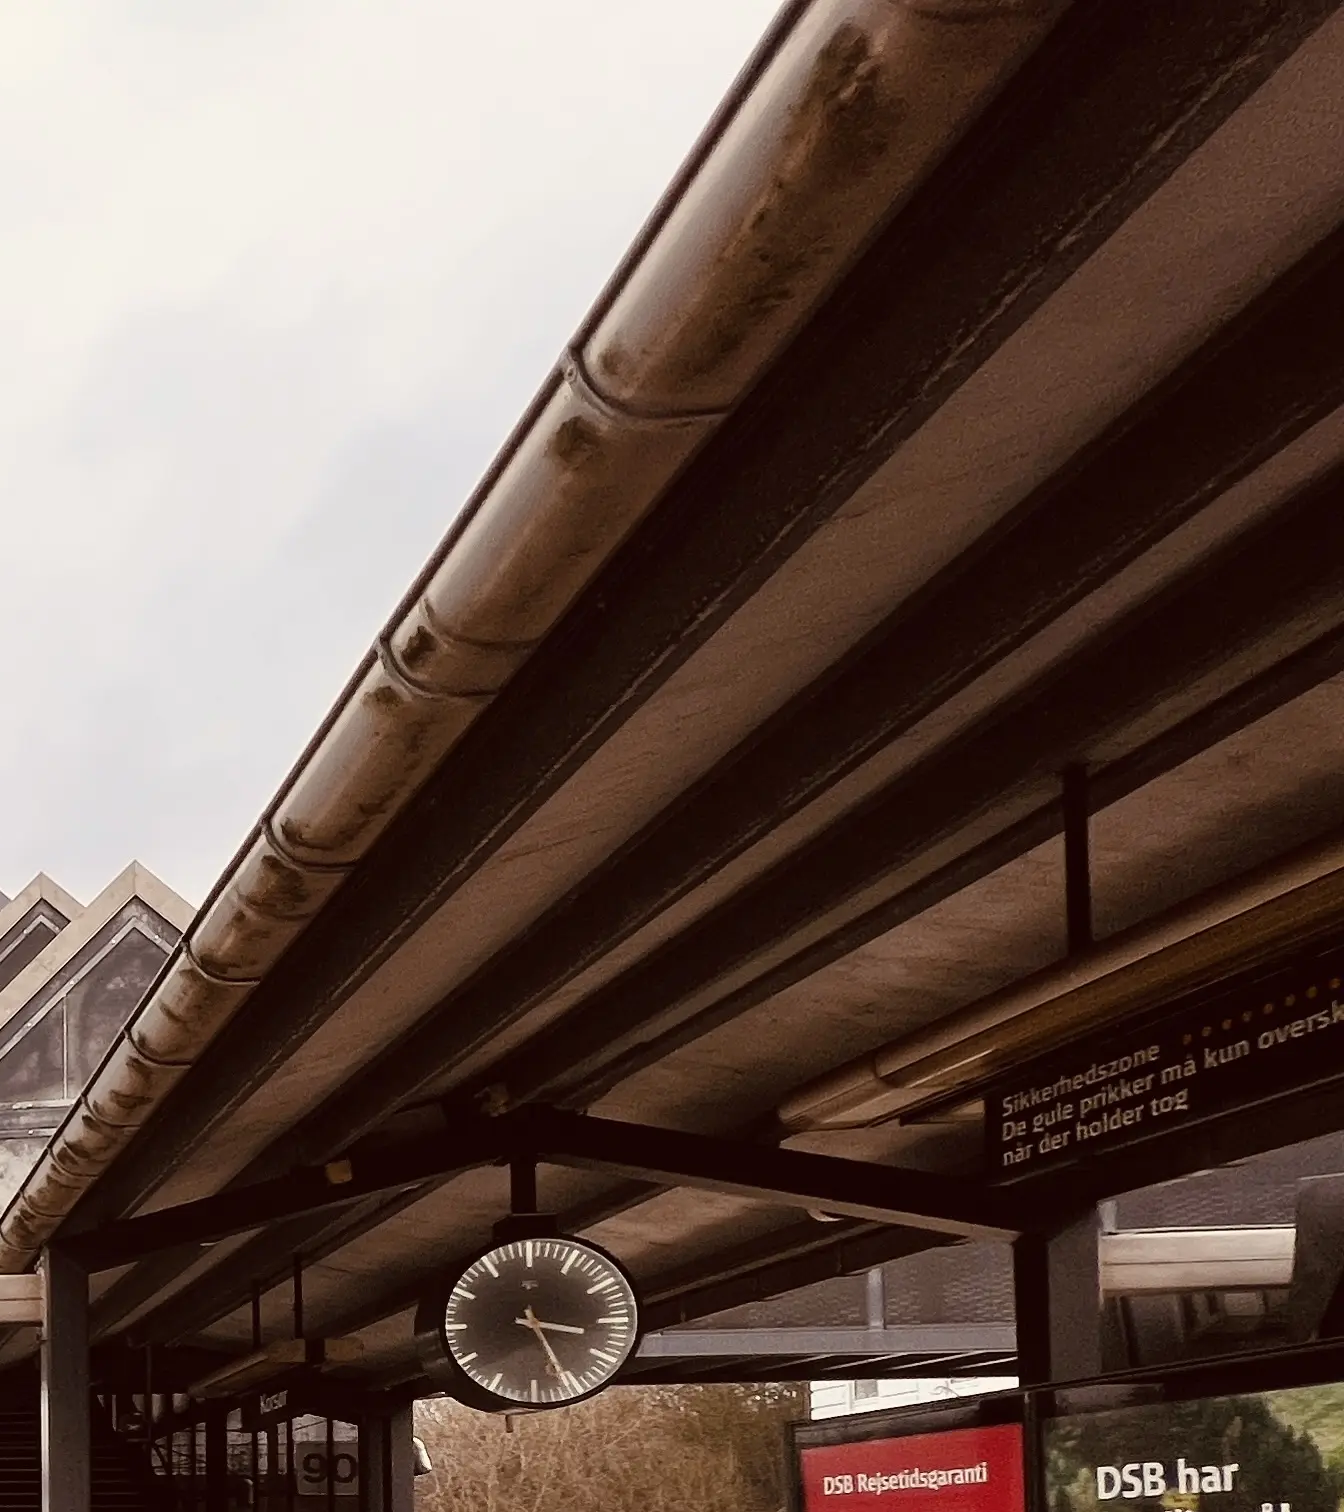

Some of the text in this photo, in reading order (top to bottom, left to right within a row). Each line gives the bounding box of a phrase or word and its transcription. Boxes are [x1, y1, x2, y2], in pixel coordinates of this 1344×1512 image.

[1002, 1044, 1160, 1117] Sikkerhedszone
[1002, 1121, 1027, 1141] De
[1032, 1102, 1074, 1134] gule
[1080, 1073, 1154, 1119] prikker
[1161, 1053, 1197, 1086] må
[1203, 1039, 1250, 1070] kun
[1003, 1086, 1190, 1166] når der holder tog
[302, 1452, 357, 1484] 90
[824, 1462, 989, 1497] DSB Rejsetidsgaranti
[1096, 1457, 1240, 1500] DSB har
